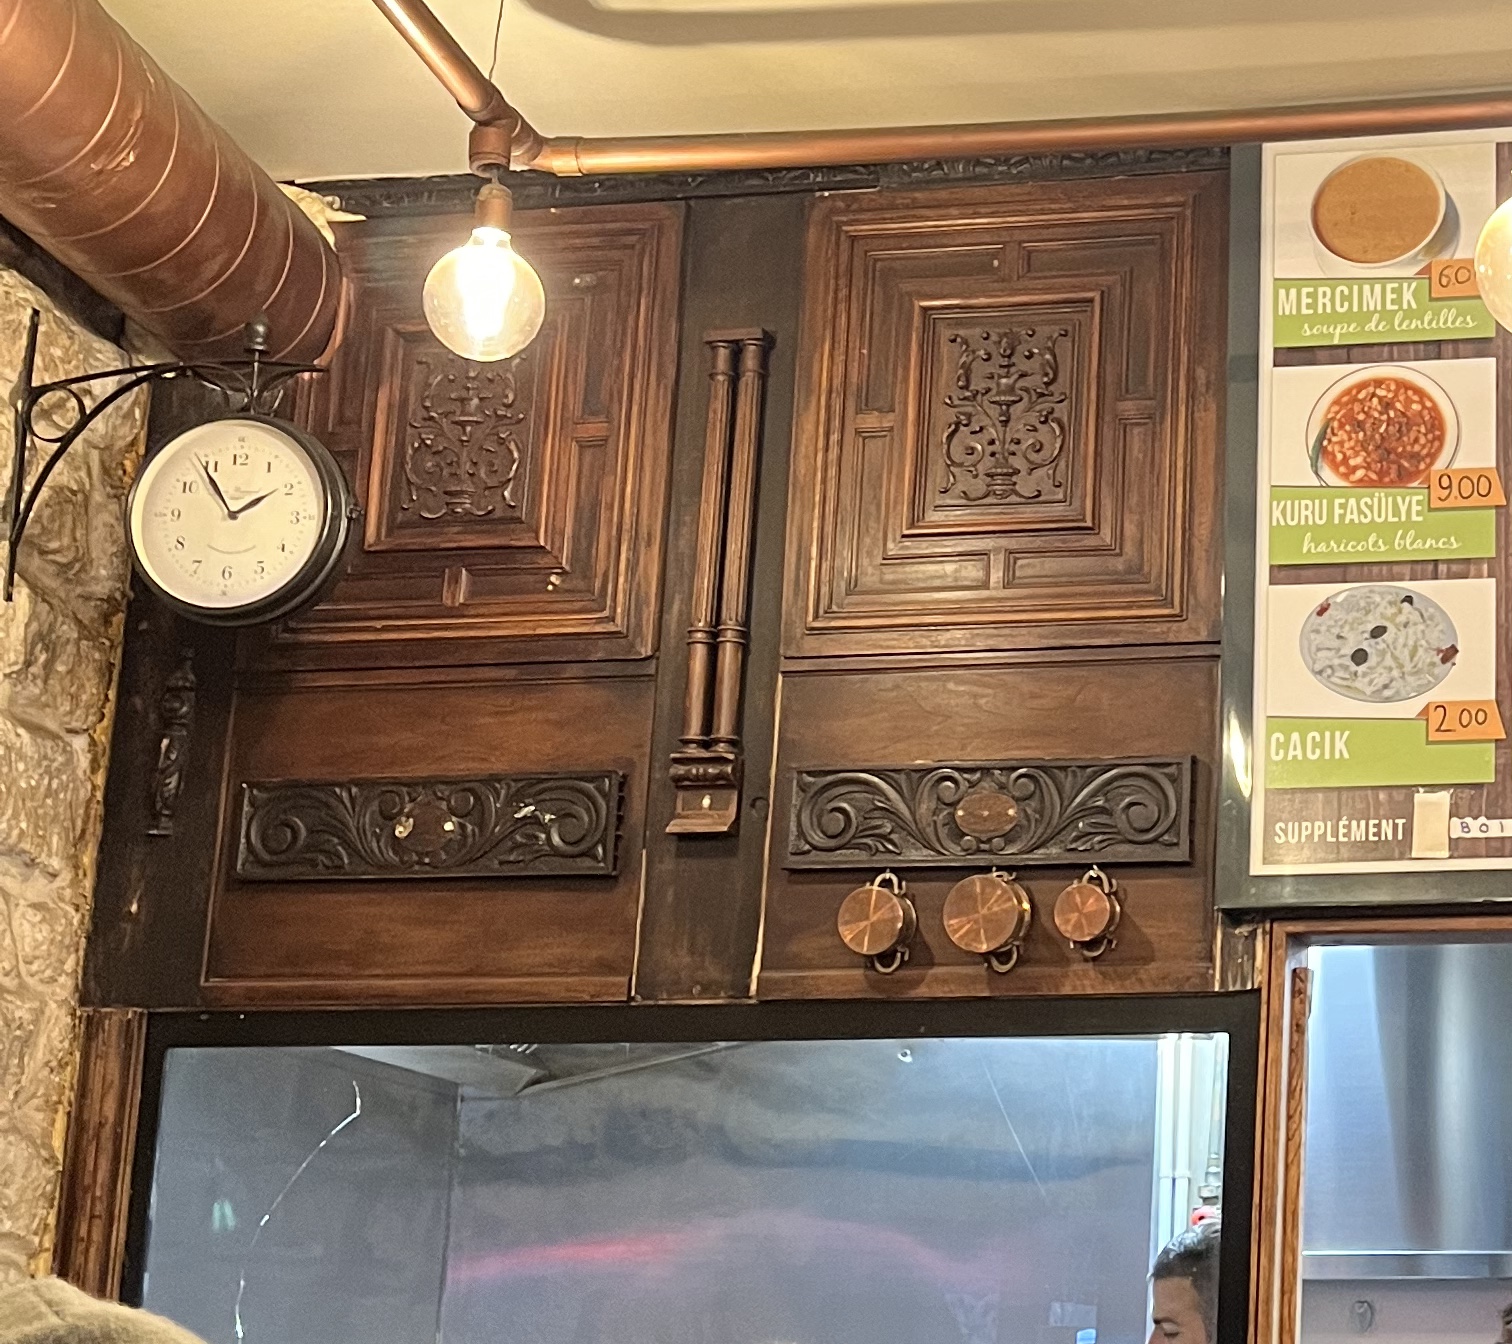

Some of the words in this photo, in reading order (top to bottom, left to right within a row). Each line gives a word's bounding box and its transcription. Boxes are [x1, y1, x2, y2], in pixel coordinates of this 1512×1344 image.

[1438, 264, 1472, 289] 6.0
[1277, 281, 1418, 316] MERCIMEK
[1301, 320, 1361, 344] soupe
[1364, 312, 1391, 333] de
[1393, 307, 1478, 332] lentilles
[232, 452, 249, 466] 12
[1437, 472, 1493, 502] 9.00
[1271, 499, 1328, 527] KURU
[1333, 492, 1424, 525] FASÜLYE
[1302, 532, 1390, 555] haricots
[1394, 529, 1462, 551] blancs
[1270, 730, 1351, 762] CACIK
[1273, 815, 1407, 845] SUPPLÉMENT
